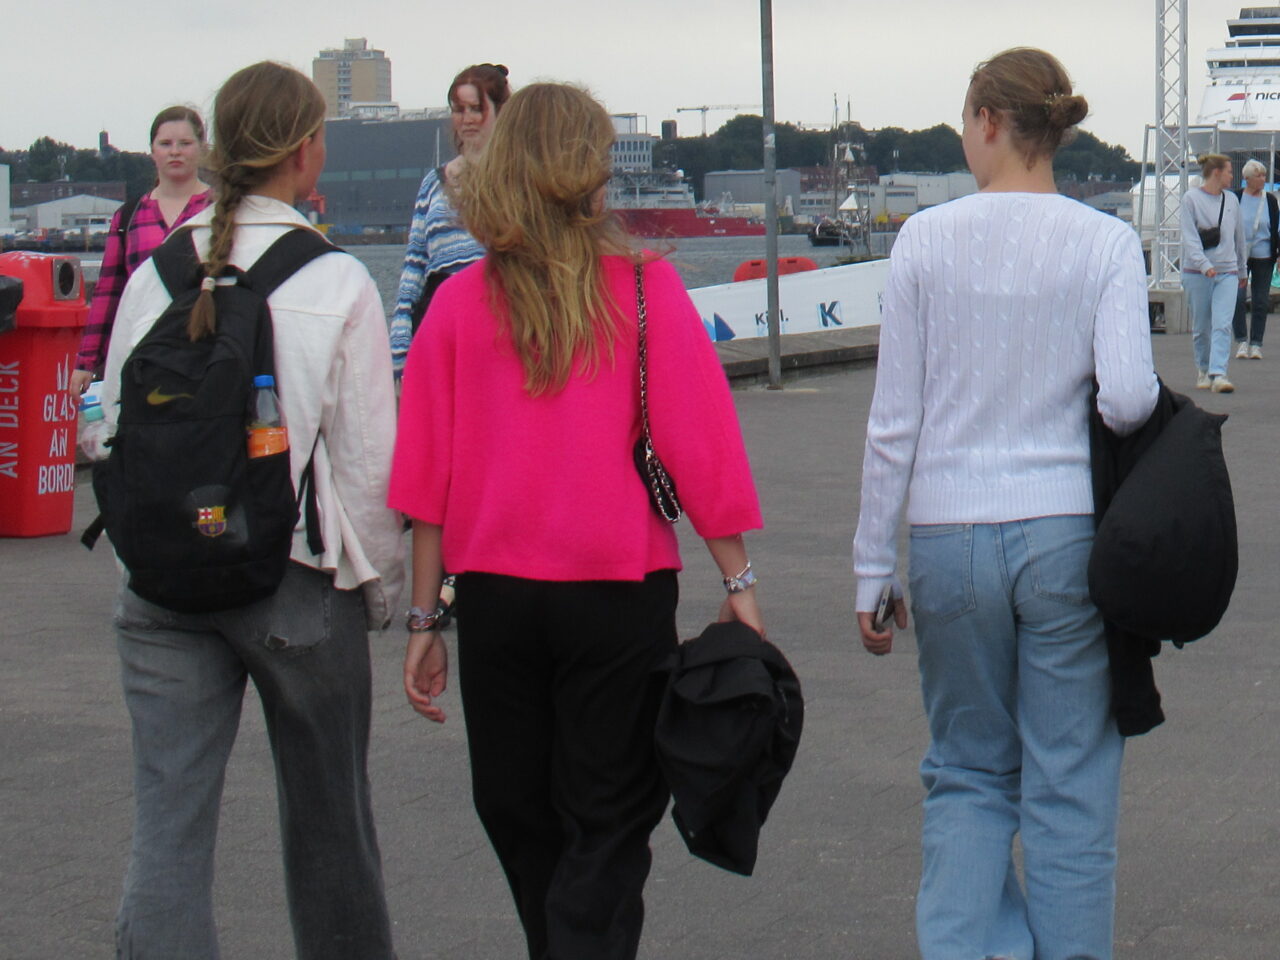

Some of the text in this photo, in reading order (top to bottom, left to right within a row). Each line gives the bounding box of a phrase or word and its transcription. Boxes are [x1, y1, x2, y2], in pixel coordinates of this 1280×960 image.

[0, 360, 20, 478] AN DECK
[43, 394, 76, 422] GLAS
[49, 428, 68, 457] AN
[38, 463, 74, 494] BORD!
